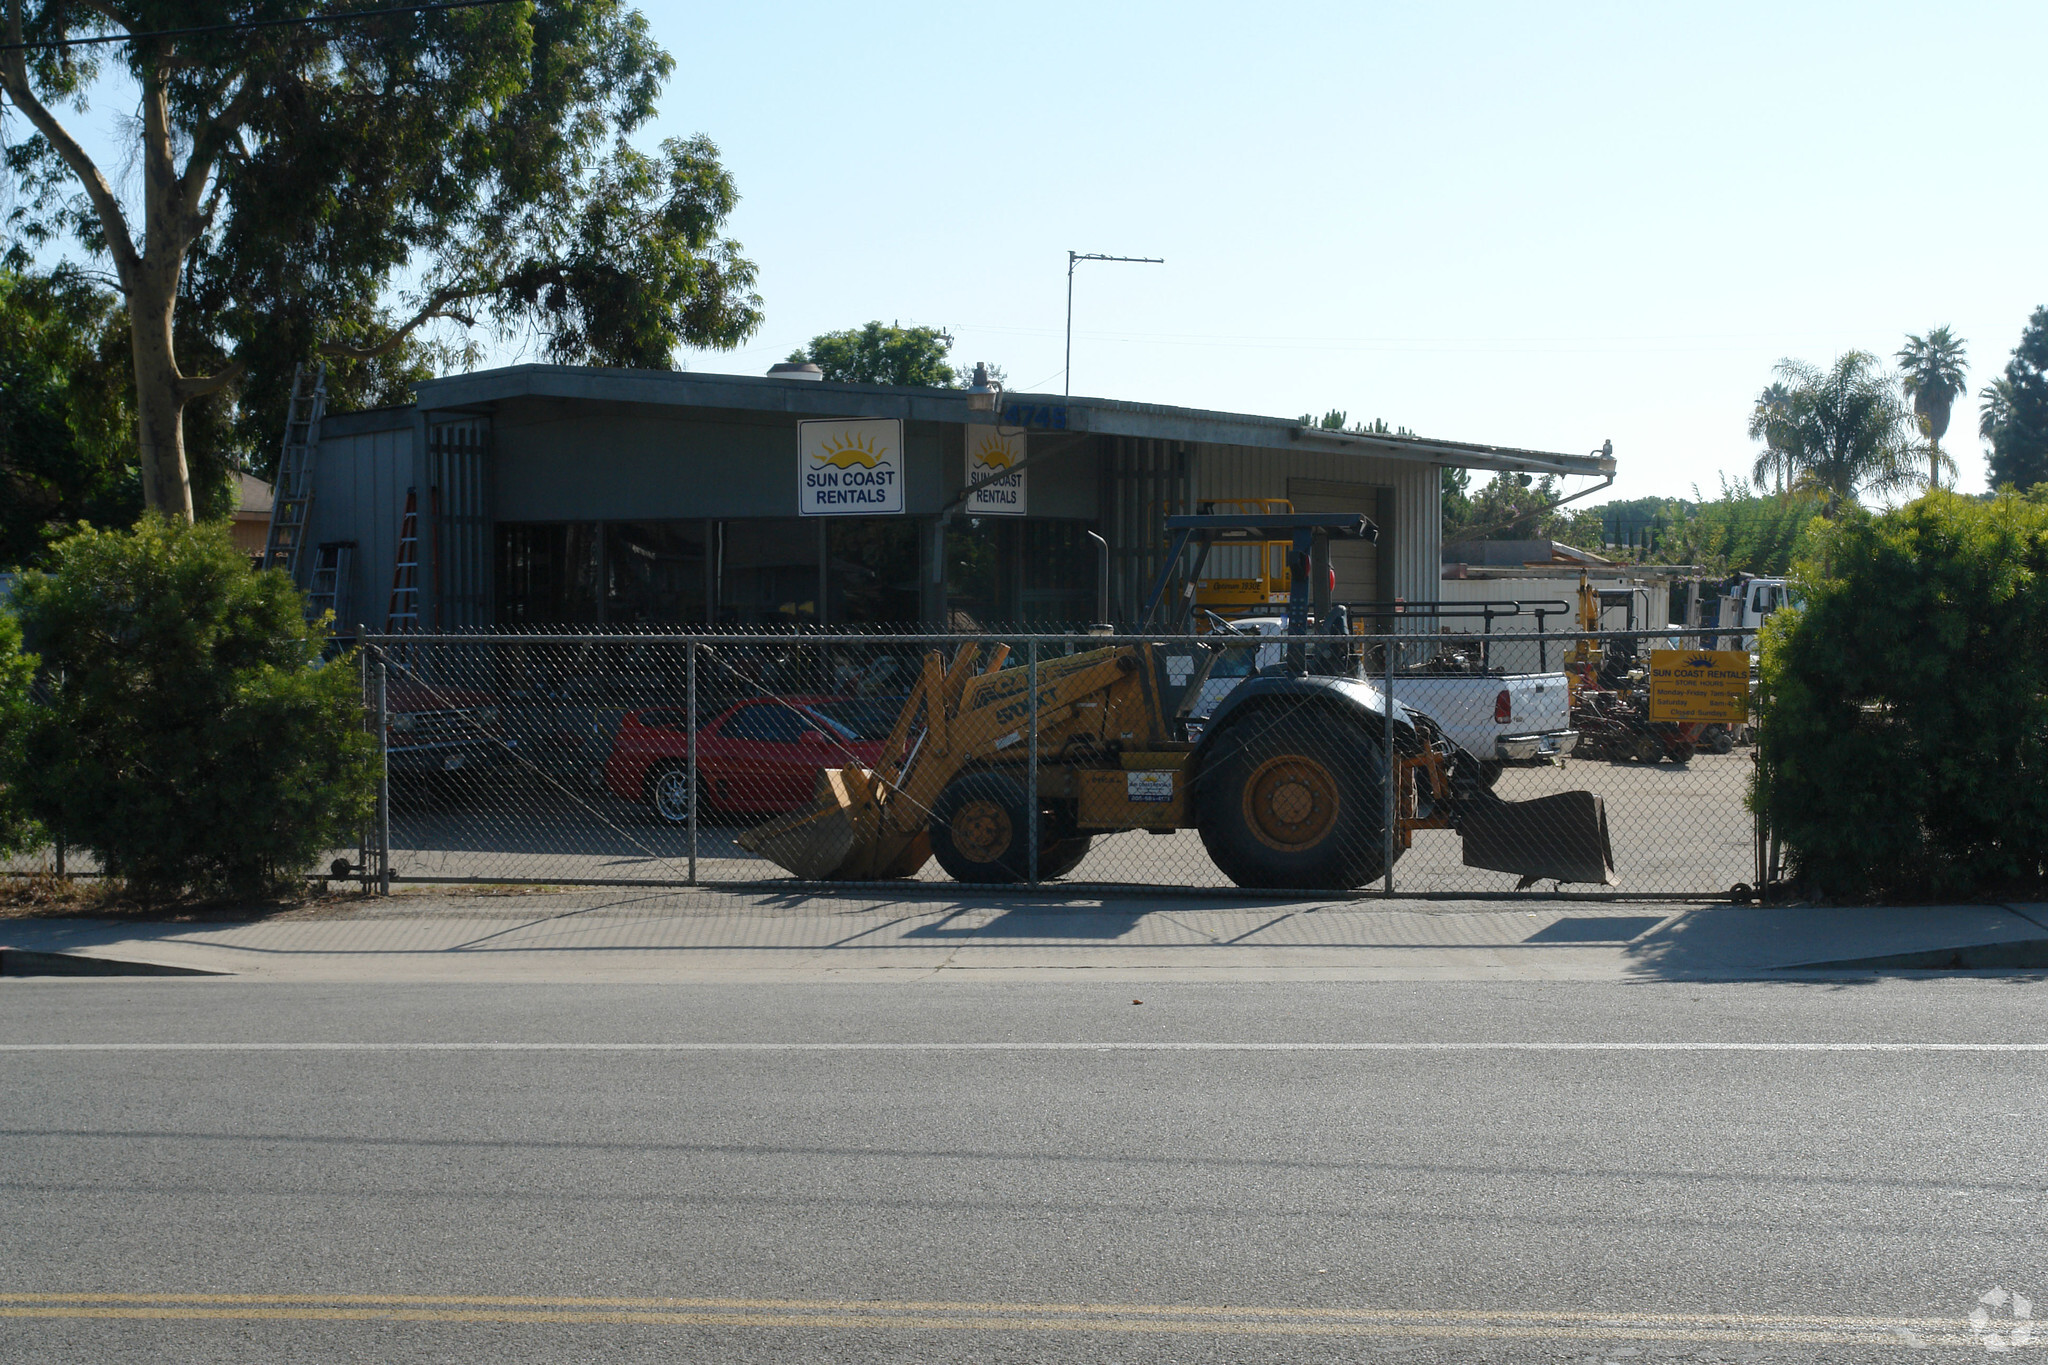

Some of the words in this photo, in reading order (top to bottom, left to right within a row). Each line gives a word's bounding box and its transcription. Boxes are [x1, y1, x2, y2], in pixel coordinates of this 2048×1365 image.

[1004, 405, 1066, 429] 4745
[806, 473, 839, 487] SUN
[842, 471, 895, 486] COAST
[816, 489, 886, 504] RENTALS
[976, 488, 1017, 504] RENTALS
[1653, 668, 1672, 677] SUN
[1674, 669, 1705, 678] COAST
[1707, 670, 1748, 679] RENTALS
[1657, 698, 1688, 706] Saturday
[1709, 700, 1742, 708] 8am-4p
[1670, 708, 1695, 716] Closed
[1697, 709, 1727, 717] Sundays
